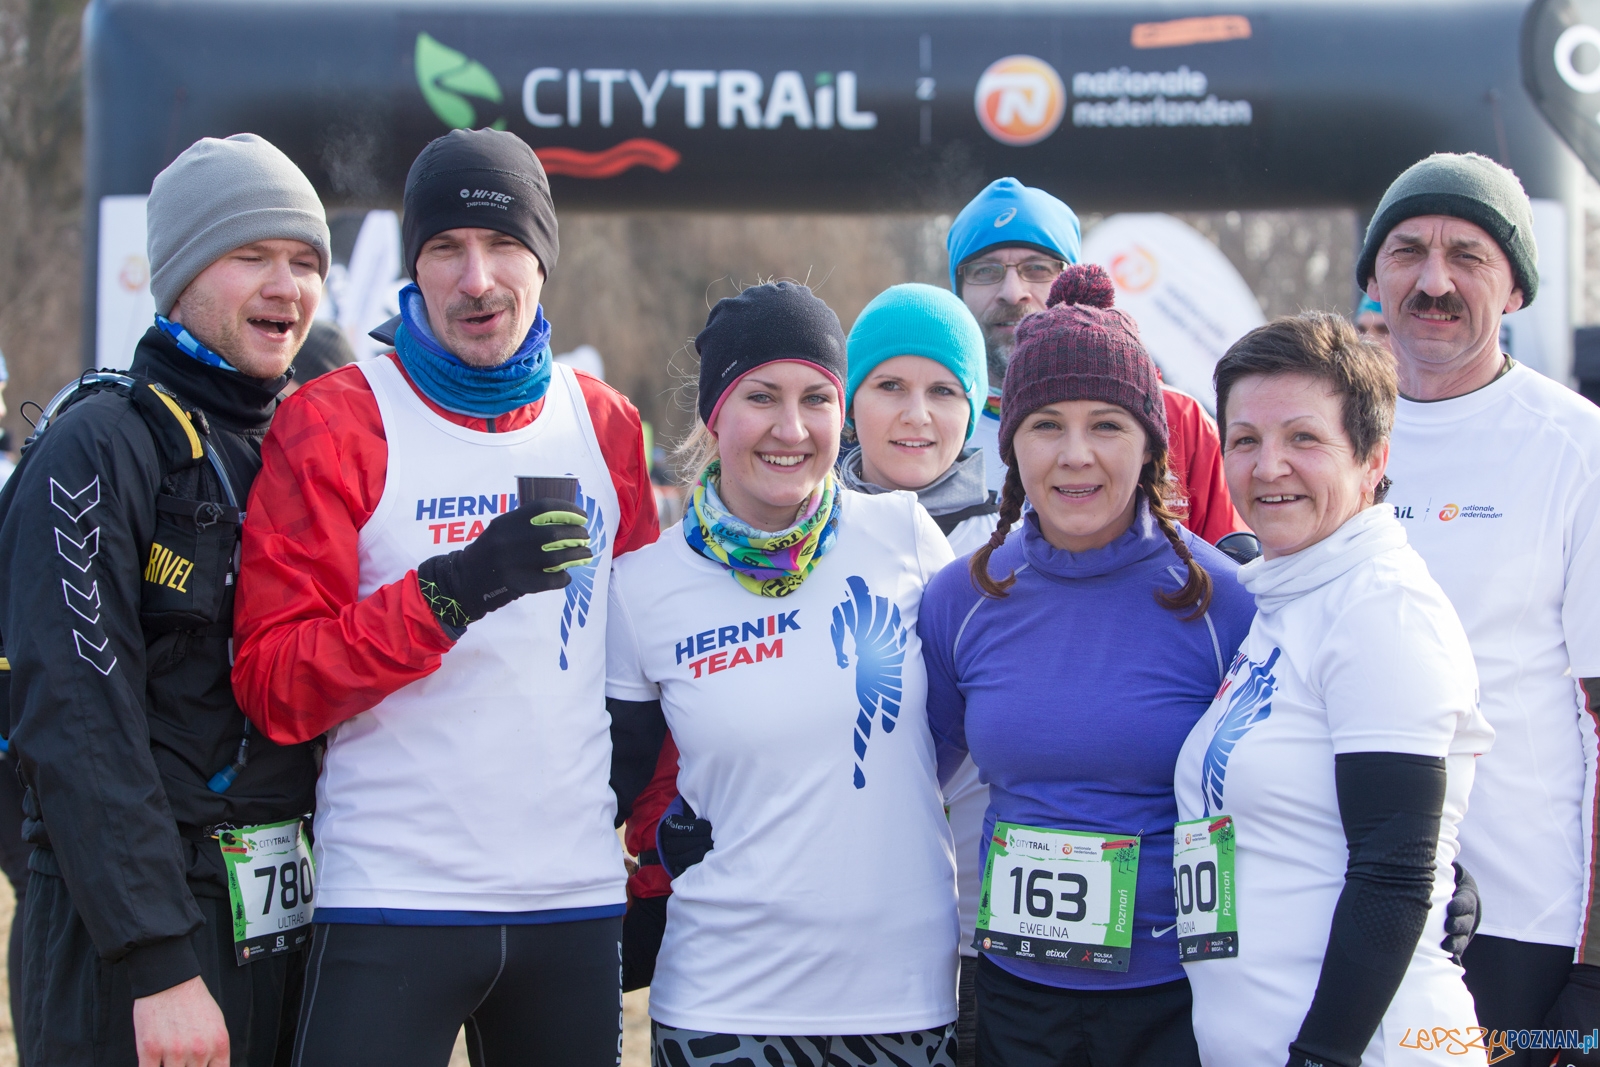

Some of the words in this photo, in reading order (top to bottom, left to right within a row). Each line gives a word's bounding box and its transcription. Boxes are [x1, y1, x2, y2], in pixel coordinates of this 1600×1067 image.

[1072, 65, 1207, 97] nationale
[1072, 94, 1252, 127] nederlanden
[1459, 511, 1503, 519] nederlanden
[1461, 504, 1495, 512] nationale
[428, 519, 493, 544] TEA
[144, 541, 194, 594] RIVEL
[675, 608, 802, 666] HERNIK
[688, 638, 783, 680] TEAM
[254, 857, 313, 916] 780
[1009, 866, 1088, 923] 163
[1222, 871, 1231, 916] Poznań
[277, 911, 305, 930] ULTRAS
[1115, 889, 1129, 933] Poznań
[1019, 921, 1069, 939] EWELINA
